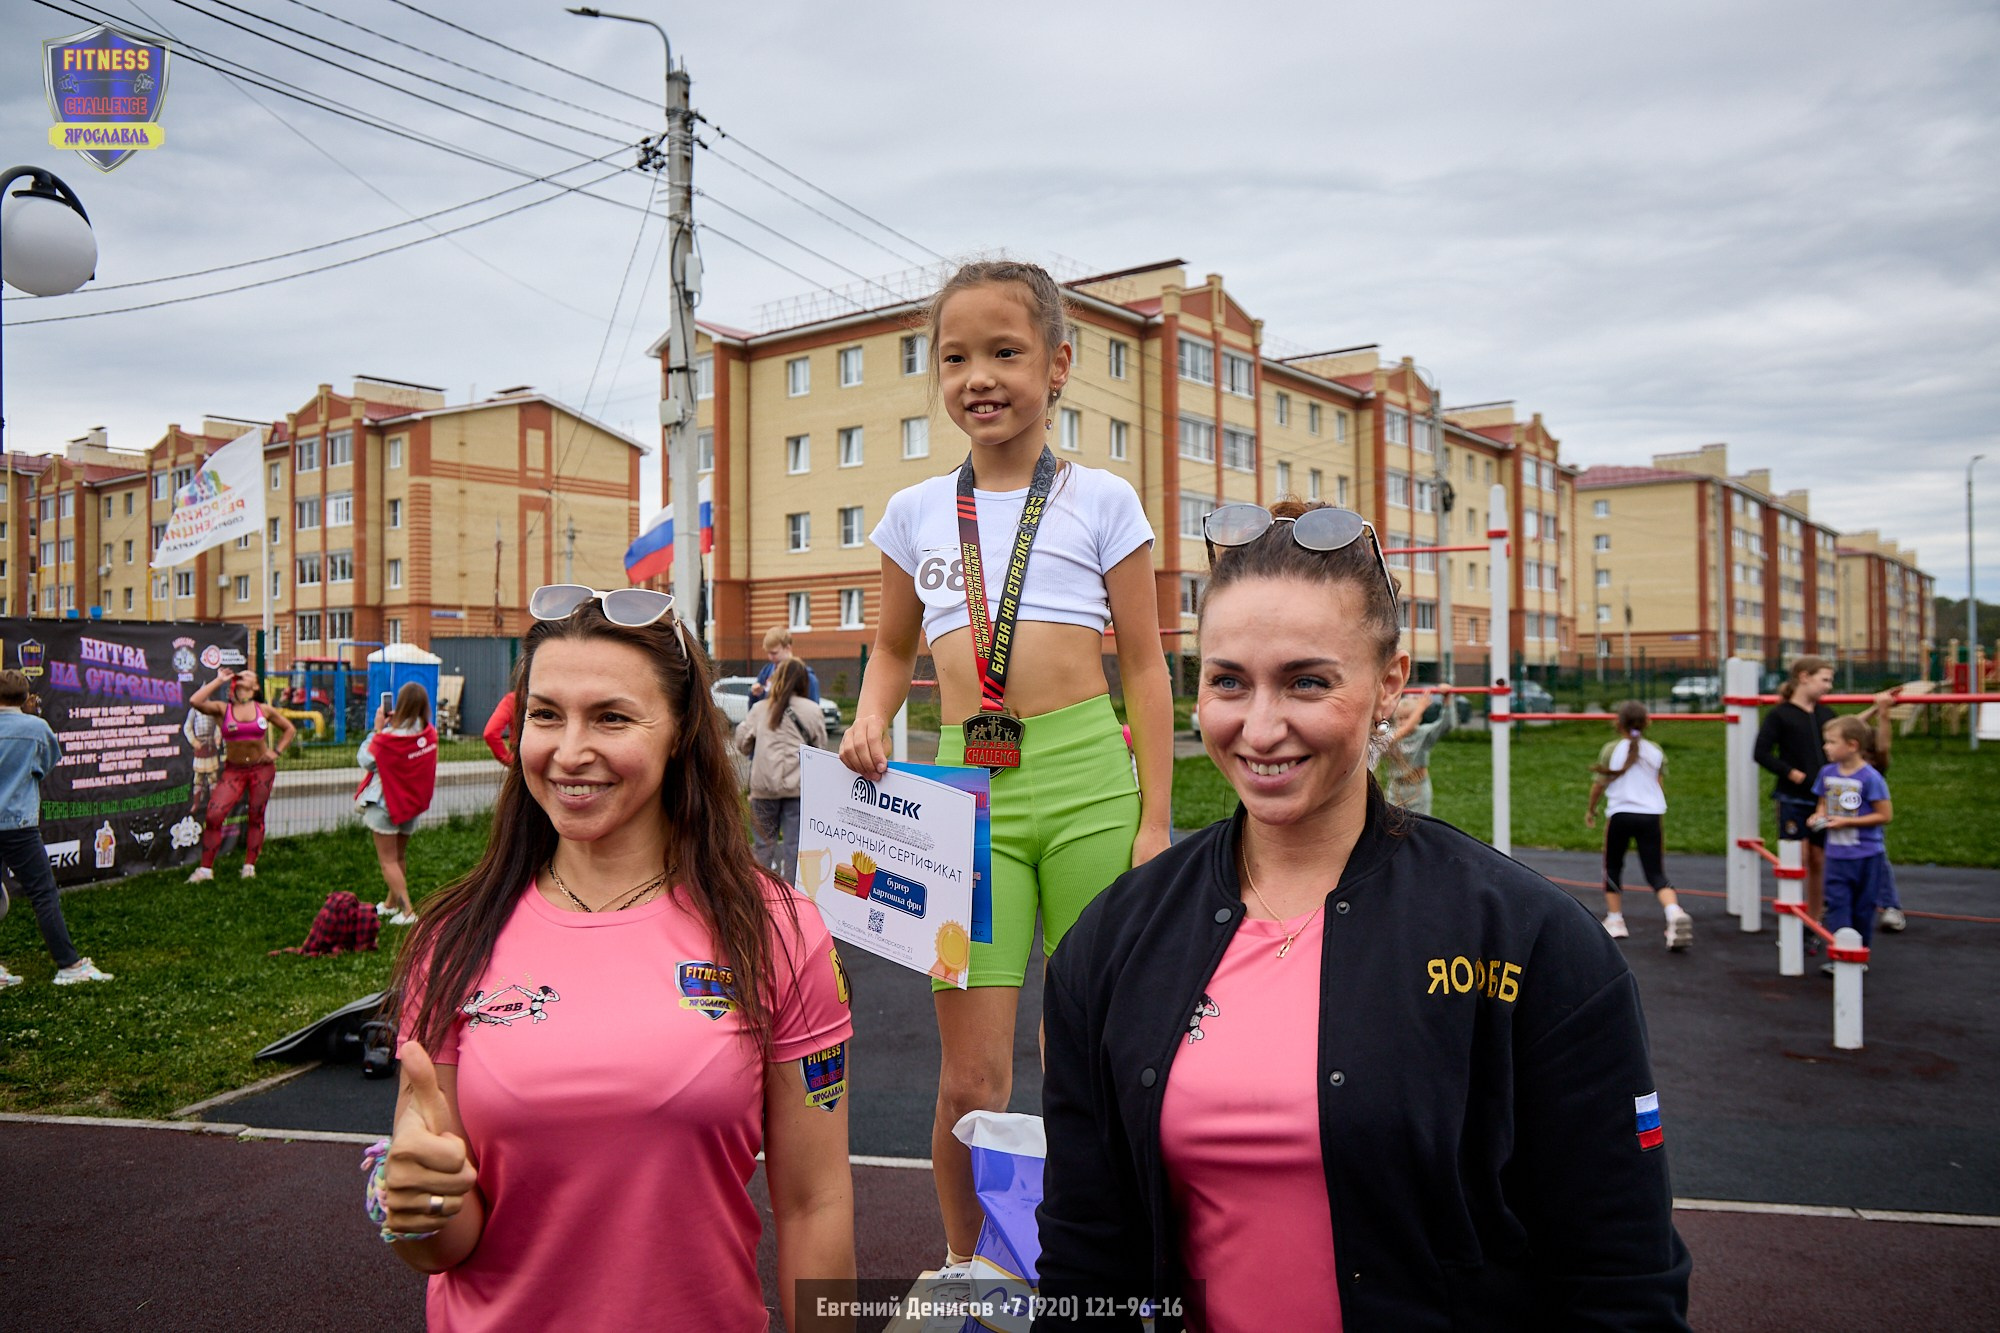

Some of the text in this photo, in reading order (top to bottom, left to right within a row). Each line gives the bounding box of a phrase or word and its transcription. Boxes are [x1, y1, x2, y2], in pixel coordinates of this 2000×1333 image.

[1026, 506, 1042, 516] 08
[1030, 496, 1045, 506] 17
[1022, 515, 1039, 525] 24
[919, 557, 966, 592] 68
[962, 543, 984, 658] КУБОК ЯРОСЛАВСКОЙ ОБЛАСТИ
[970, 544, 991, 660] ПО ФИТНЕС-ЧЕЛЛЕНДЖУ
[991, 531, 1032, 675] БИТВА НА СТРЕЛКЕ
[80, 636, 149, 672] БИТВА
[50, 660, 183, 706] НА СТРЕЛКЕ!
[971, 741, 1015, 749] FITNESS
[966, 749, 1019, 764] CHALLENGE
[878, 792, 922, 821] DEKK
[48, 851, 78, 868] EKK
[809, 818, 886, 856] ПОДАРОЧНЫЙ
[888, 846, 962, 884] СЕРТИФИКАТ
[887, 877, 910, 895] бургер
[872, 887, 922, 913] картошка фри
[685, 966, 733, 985] FITNESS
[487, 1002, 523, 1012] IFBB
[807, 1044, 841, 1066] FITNESS
